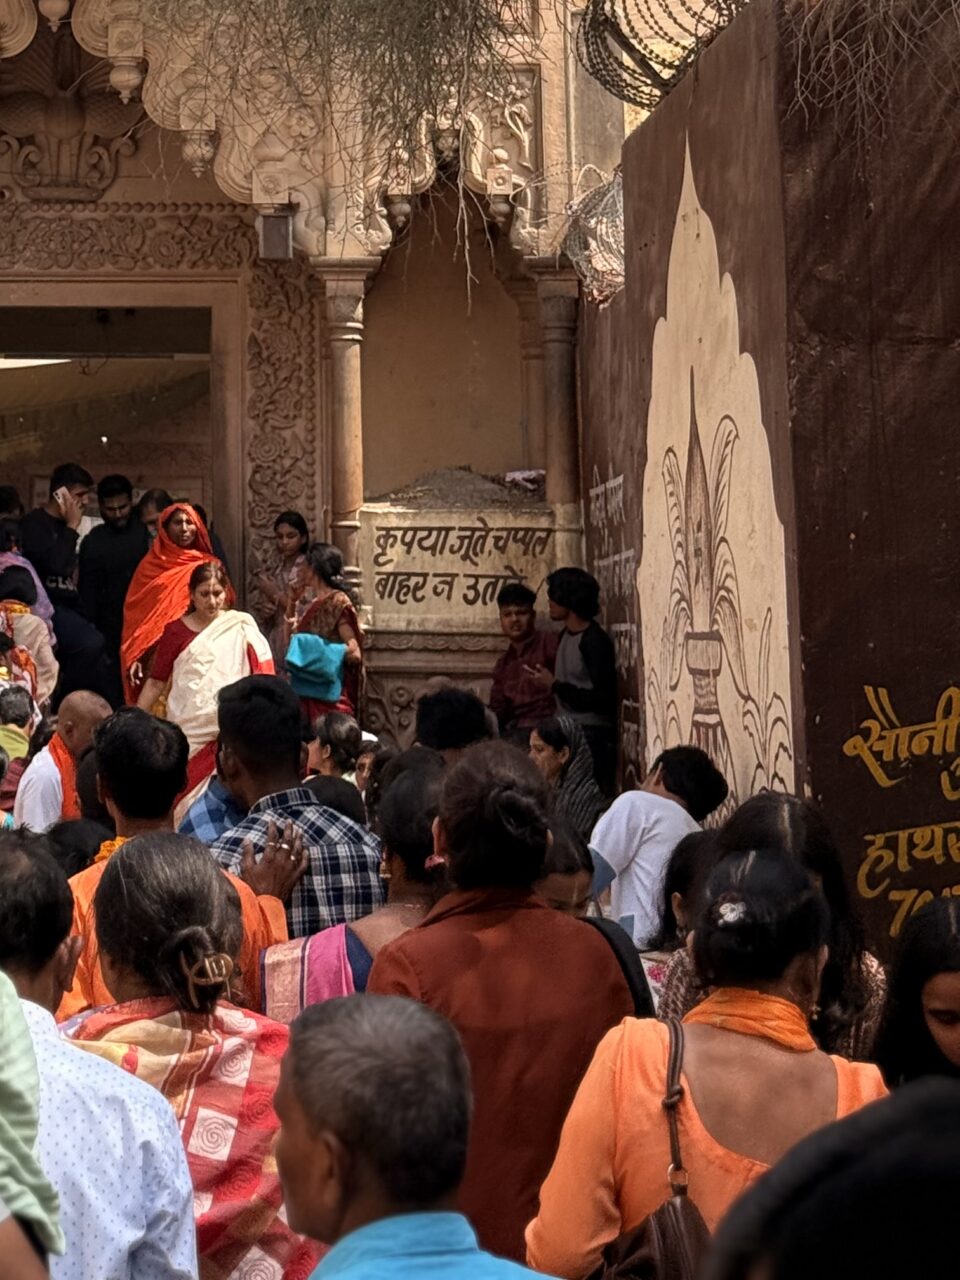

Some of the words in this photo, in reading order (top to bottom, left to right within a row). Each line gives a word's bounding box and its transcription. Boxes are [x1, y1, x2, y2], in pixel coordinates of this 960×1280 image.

[373, 526, 456, 566] कृपया
[375, 572, 429, 605] बाहर
[432, 573, 459, 601] न
